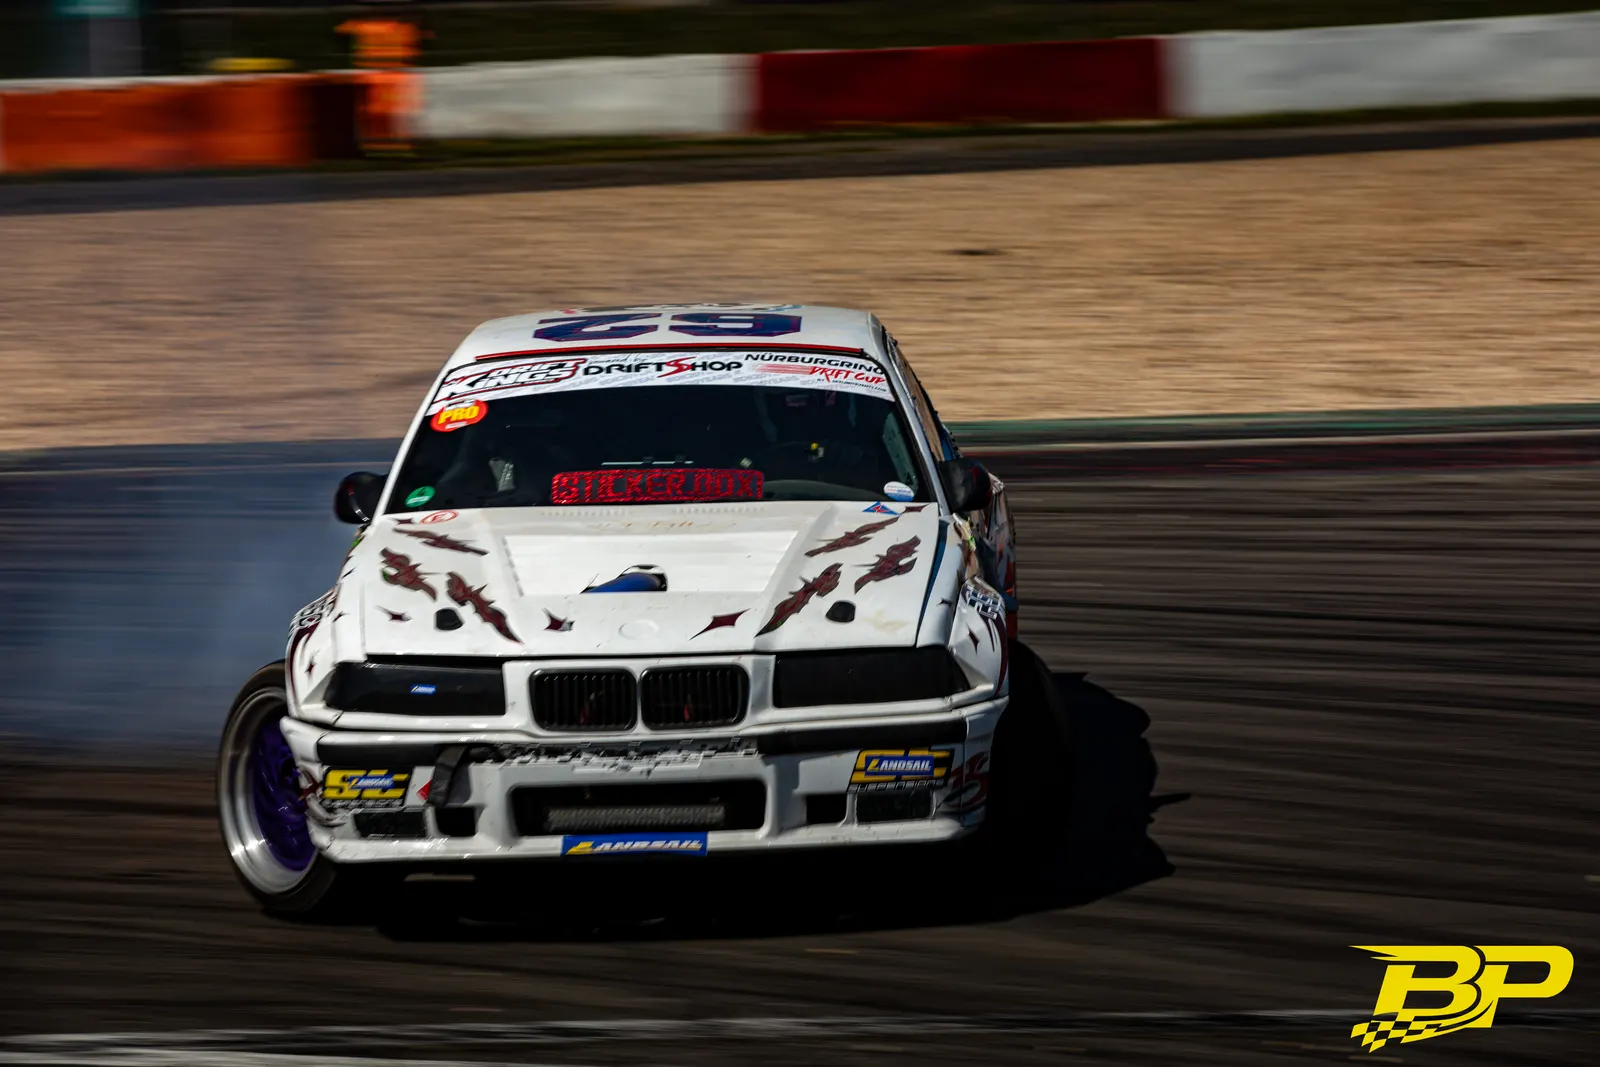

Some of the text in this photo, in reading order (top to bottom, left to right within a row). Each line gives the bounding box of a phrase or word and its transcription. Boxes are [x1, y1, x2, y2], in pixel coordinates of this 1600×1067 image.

[809, 366, 854, 383] DRIFT
[854, 372, 887, 385] CUP
[438, 405, 480, 425] PRO
[867, 758, 932, 772] LANDSAIL
[566, 839, 703, 856] LANDSAIL
